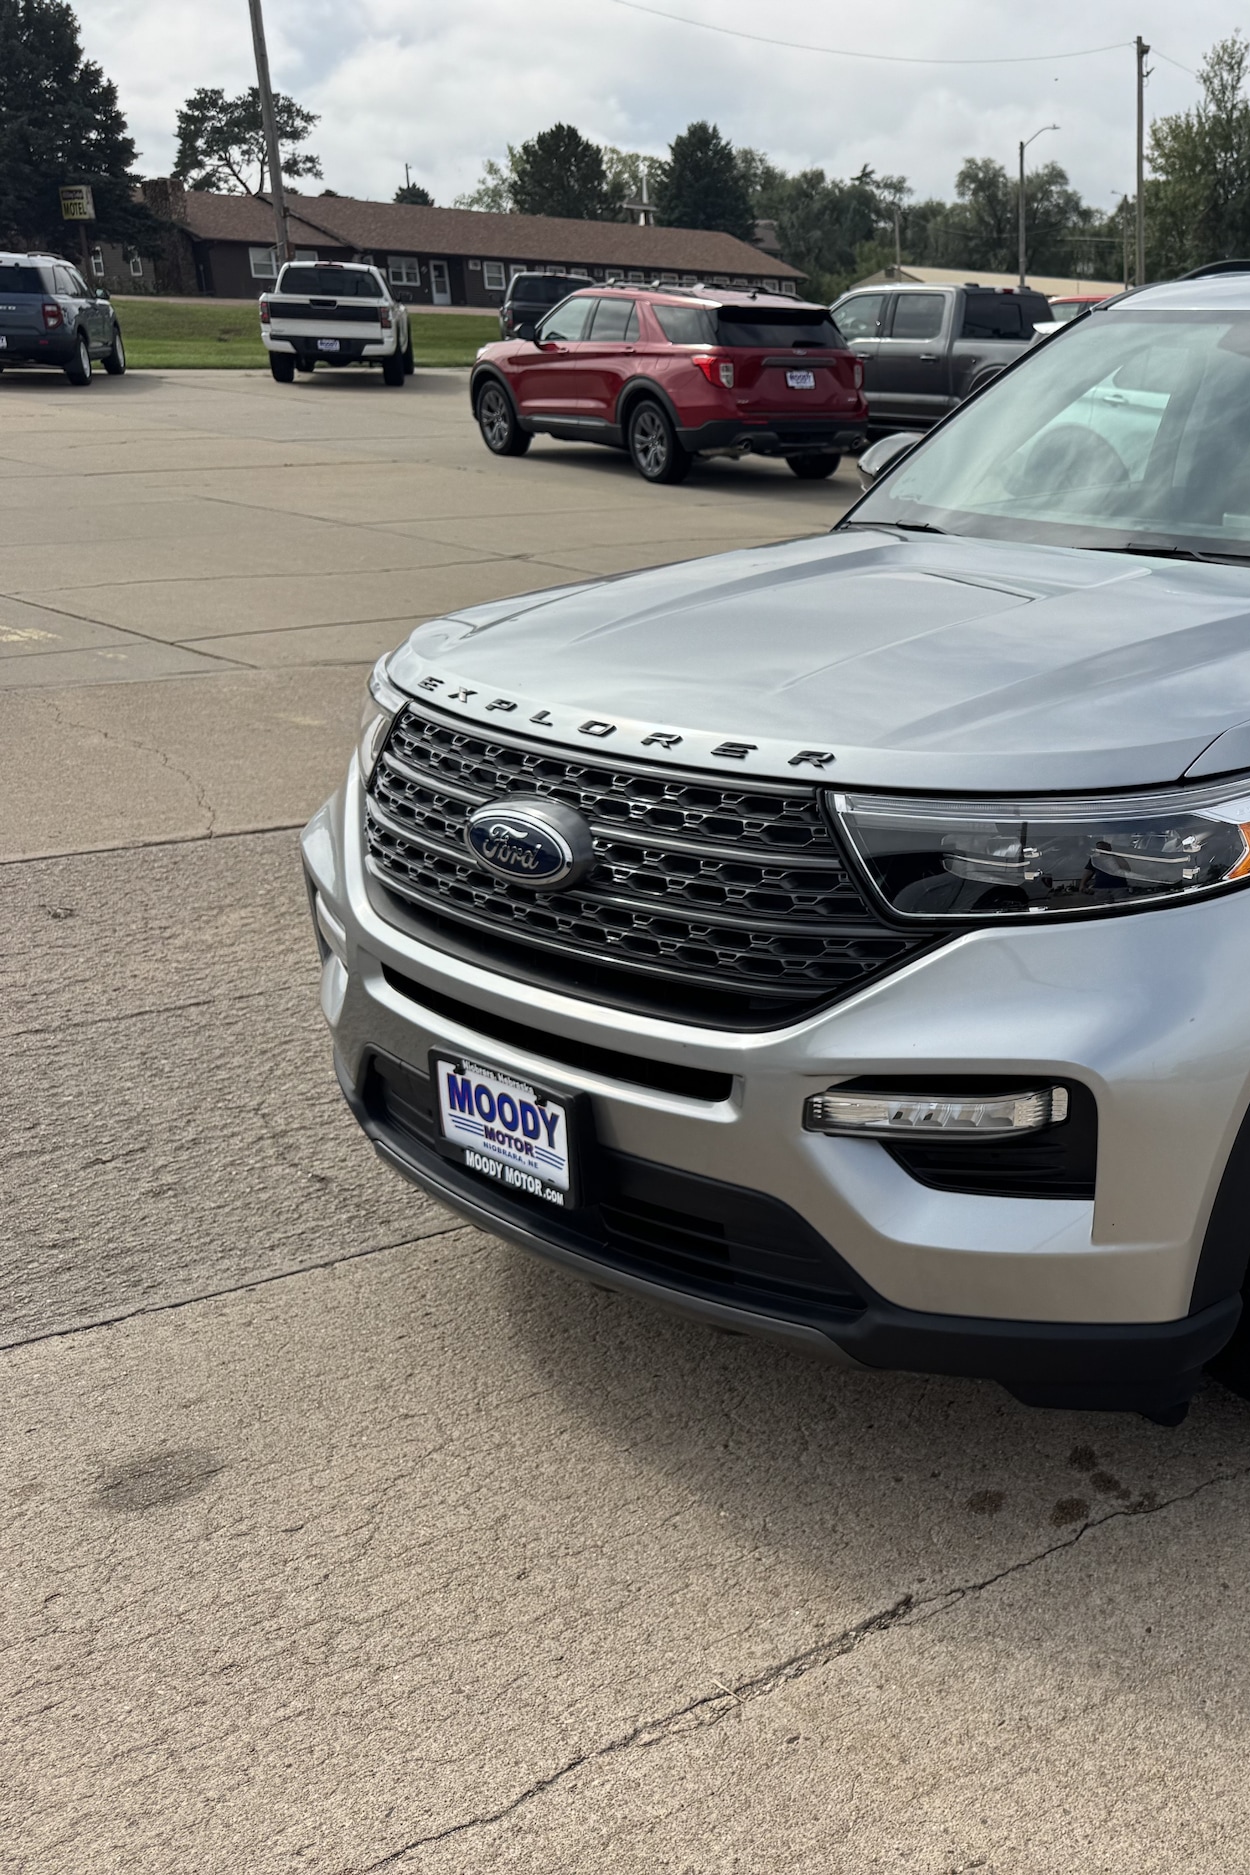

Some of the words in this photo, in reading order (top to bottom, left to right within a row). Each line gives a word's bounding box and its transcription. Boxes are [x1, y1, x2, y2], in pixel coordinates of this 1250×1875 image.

[63, 202, 87, 217] MOTEL
[417, 675, 837, 769] EXPLORER
[482, 823, 542, 869] Ford
[447, 1073, 559, 1149] MOODY
[483, 1141, 526, 1166] NIOBRARA,
[528, 1159, 539, 1169] NE
[484, 1125, 535, 1158] MOTOR
[465, 1149, 504, 1179] MOODY
